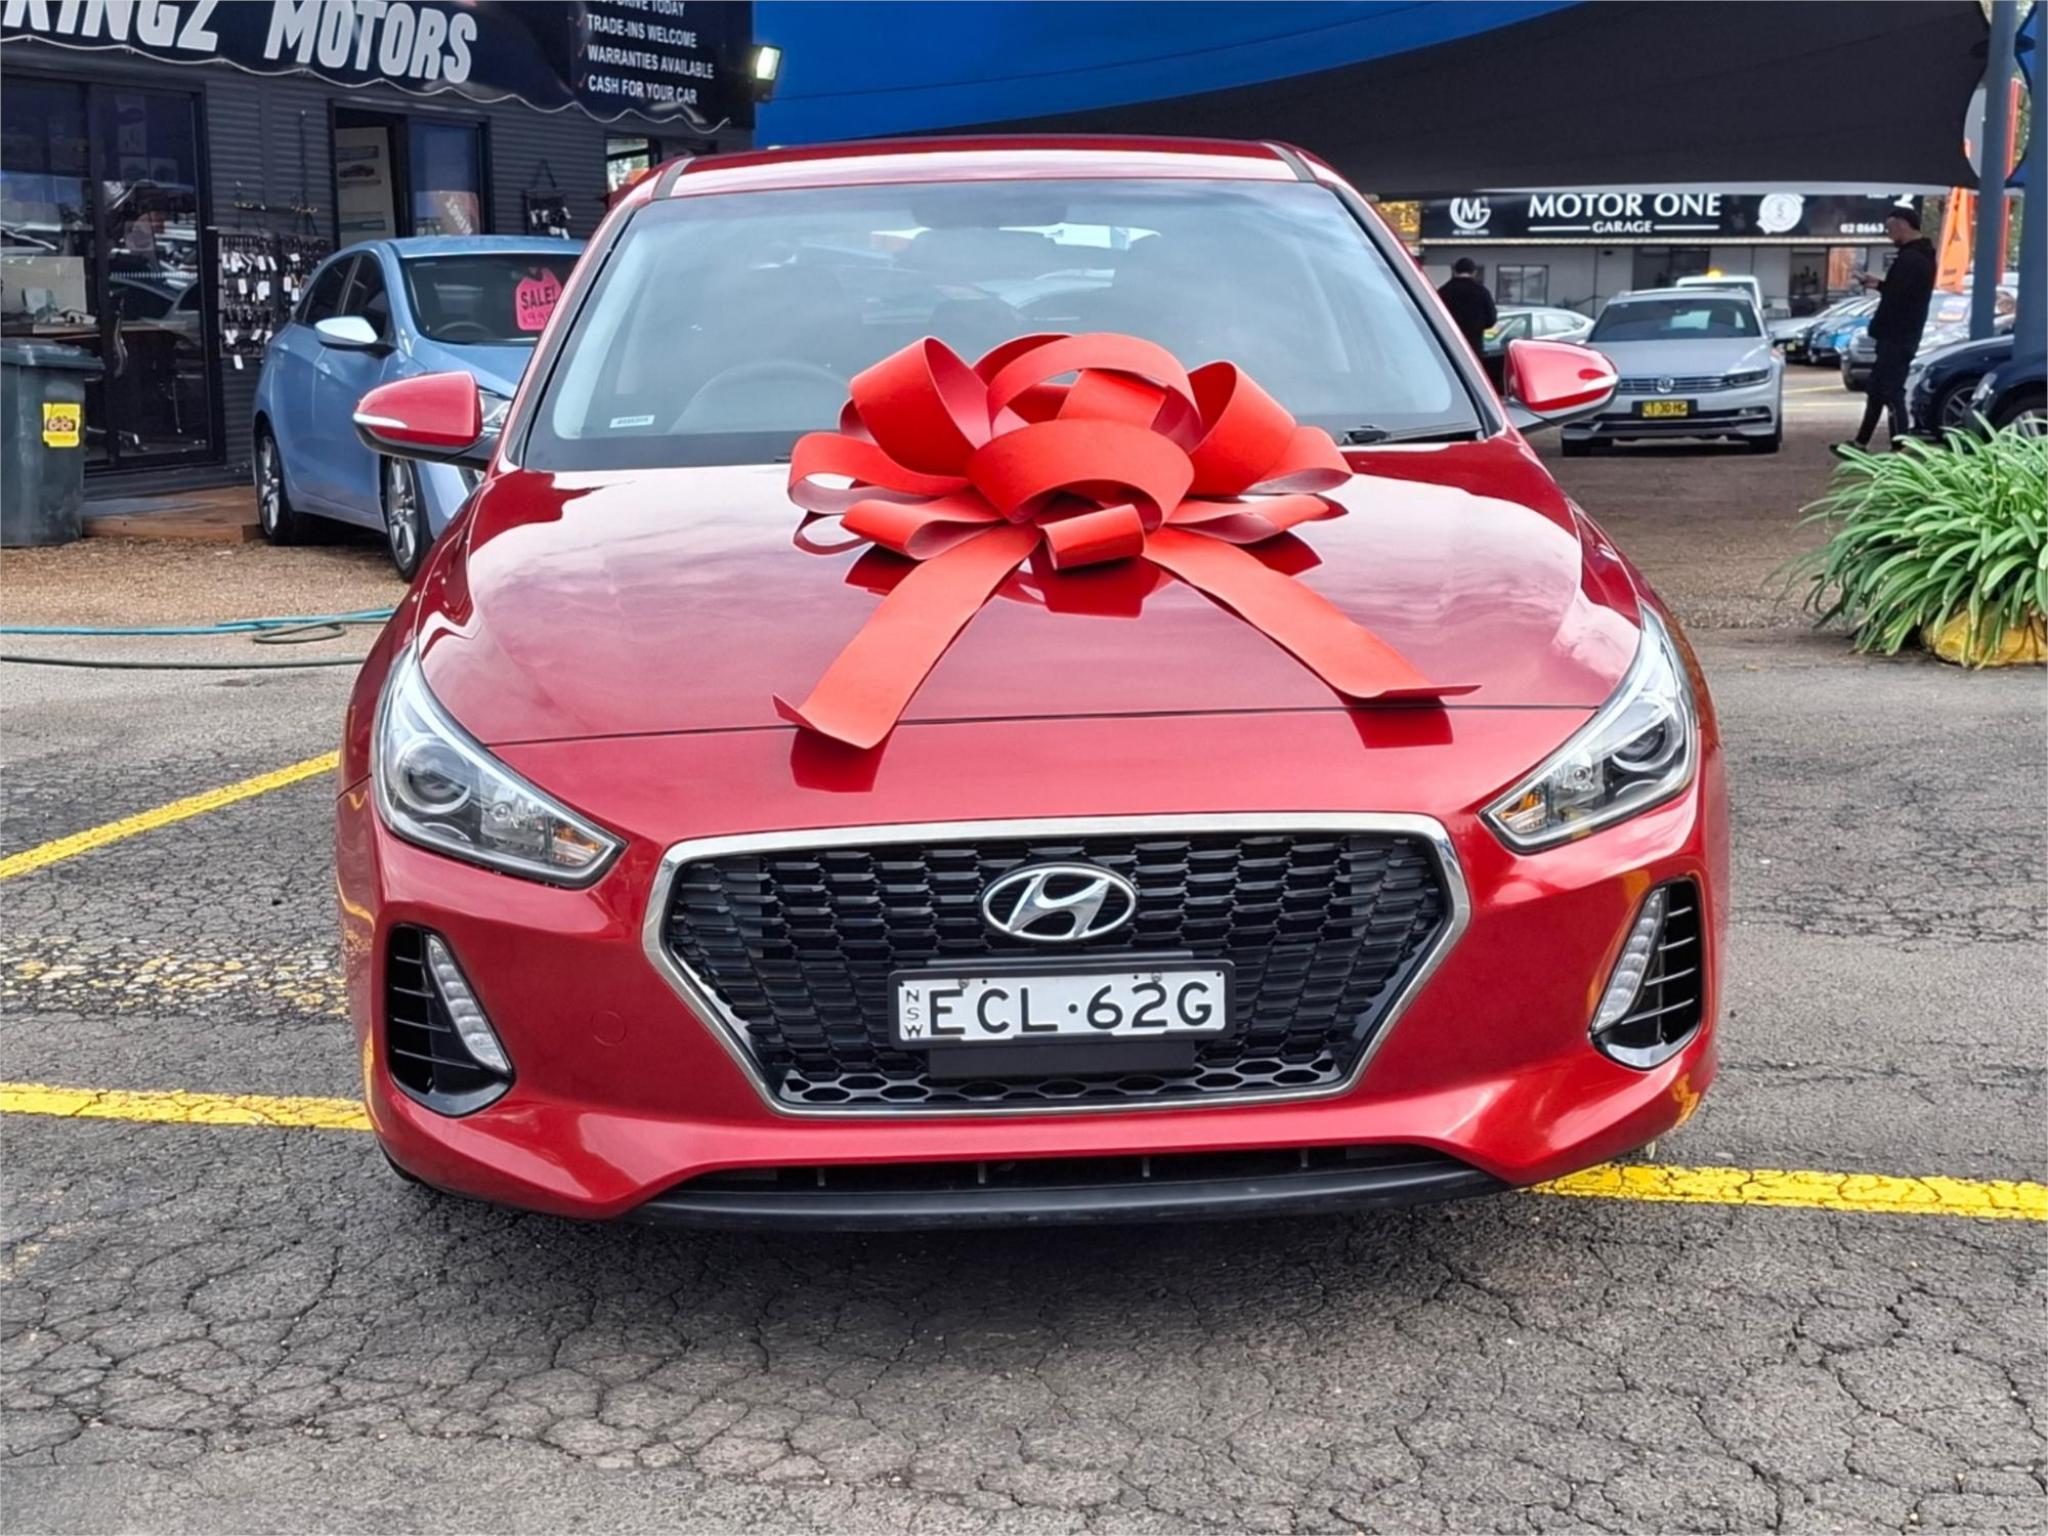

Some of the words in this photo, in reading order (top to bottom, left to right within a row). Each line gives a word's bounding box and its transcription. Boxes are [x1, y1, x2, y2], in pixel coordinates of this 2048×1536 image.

[652, 0, 685, 17] TODAY
[263, 0, 477, 84] MOTORS
[587, 14, 645, 39] TRADE-INS
[647, 24, 698, 48] WELCOME
[587, 44, 659, 71] WARRANTIES
[660, 55, 714, 79] AVAILABLE
[588, 74, 619, 95] CASH
[621, 79, 644, 98] FOR
[645, 83, 674, 102] YOUR
[676, 86, 698, 104] CAR
[1528, 193, 1644, 219] MOTOR
[1653, 192, 1722, 217] ONE
[1592, 220, 1653, 234] GARAGE
